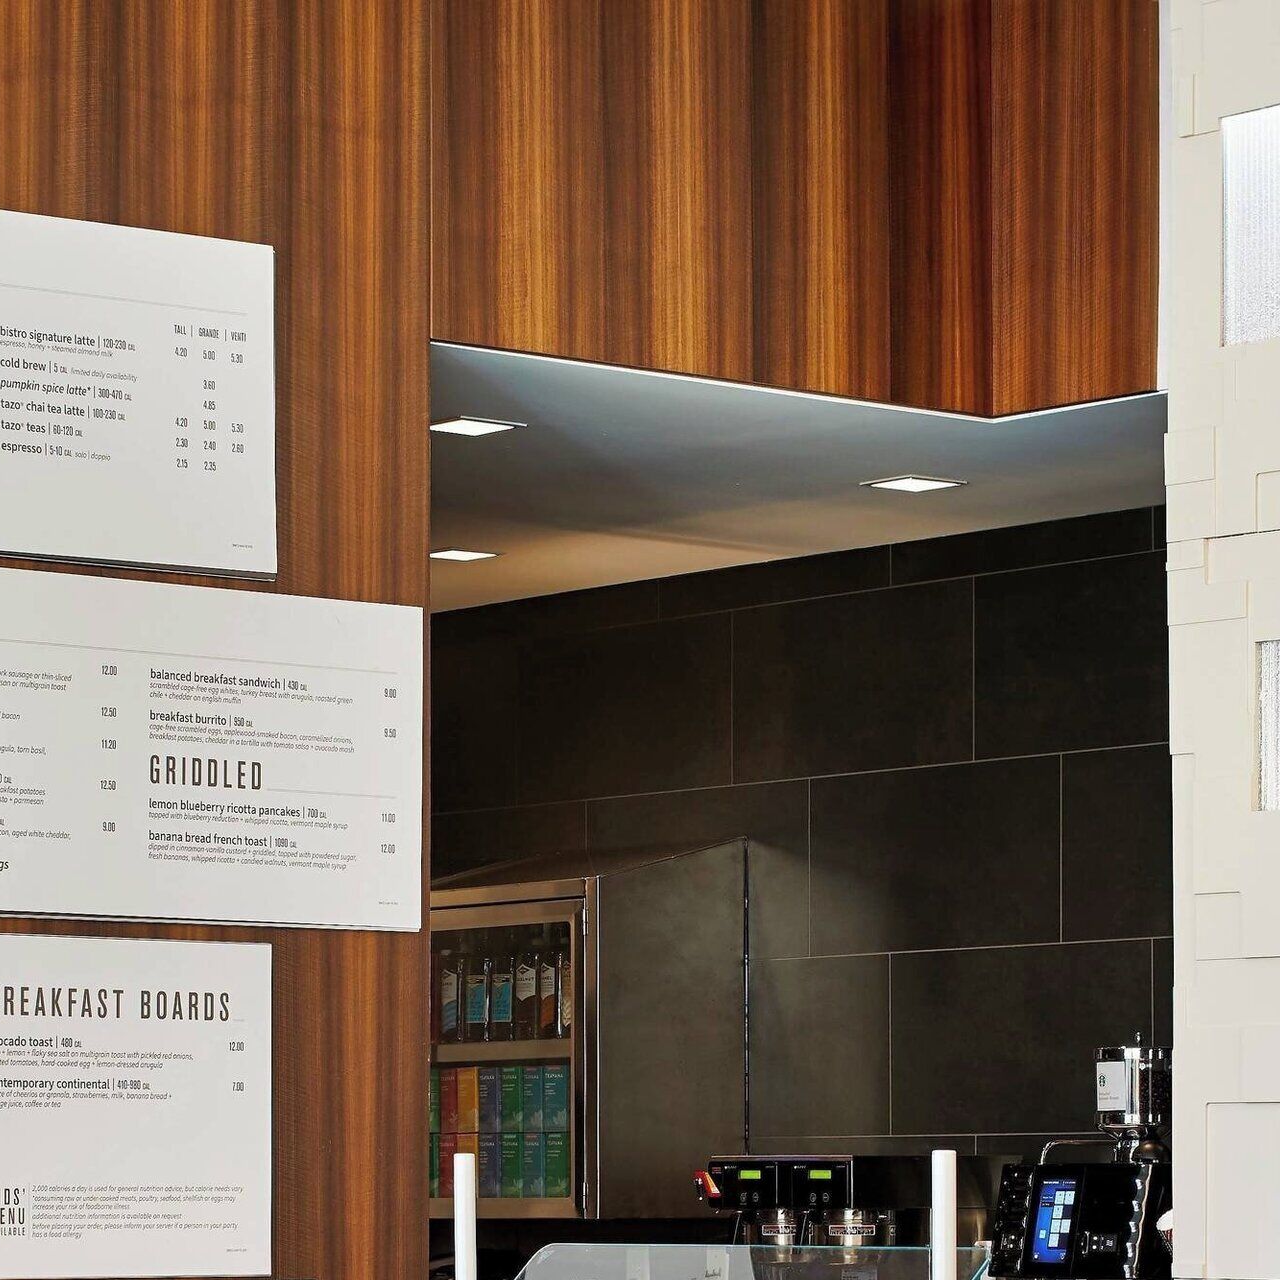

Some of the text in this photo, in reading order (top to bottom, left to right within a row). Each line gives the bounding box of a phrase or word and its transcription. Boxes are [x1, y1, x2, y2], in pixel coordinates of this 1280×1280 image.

[0, 325, 95, 346] bistro signature latte
[0, 357, 46, 371] cold brew
[0, 377, 40, 392] pumpkin
[41, 382, 64, 396] spice
[26, 401, 45, 413] chai
[47, 403, 61, 414] tea
[64, 404, 85, 417] latte
[26, 422, 46, 433] teas
[1, 442, 42, 454] espresso
[150, 668, 191, 682] balanced
[194, 671, 237, 686] breakfast
[238, 677, 280, 689] sandwich
[150, 709, 227, 726] breakfast burrito
[150, 754, 261, 790] GRIDDLED
[149, 797, 178, 810] lemon
[180, 799, 225, 814] blueberry
[227, 802, 256, 814] ricotta
[259, 806, 301, 817] pancakes
[149, 829, 267, 847] banana bread french toast
[140, 990, 229, 1022] BOARDS
[28, 1037, 53, 1047] toast
[56, 1078, 110, 1091] continental
